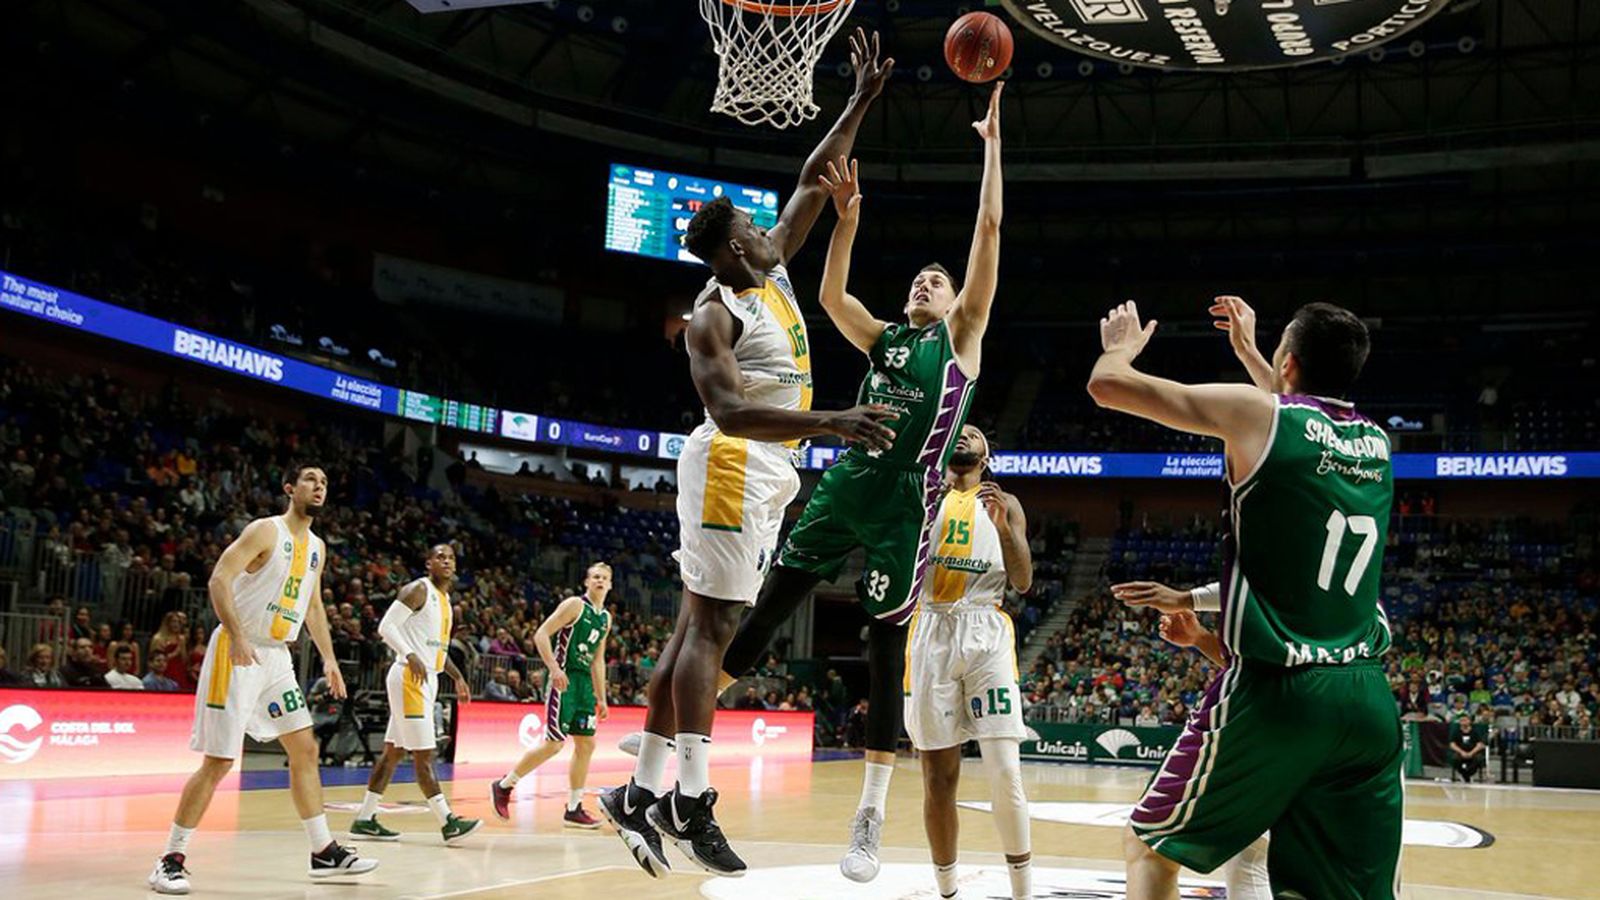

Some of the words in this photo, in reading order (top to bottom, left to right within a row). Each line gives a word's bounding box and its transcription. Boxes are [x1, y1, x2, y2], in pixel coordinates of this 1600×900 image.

[1027, 2, 1170, 64] VELAZQUEZ
[1266, 12, 1314, 55] GRUPO
[3, 275, 26, 294] The
[27, 286, 58, 305] most
[0, 292, 45, 314] natural
[46, 305, 84, 325] choice
[173, 329, 284, 382] BENAHAVIS
[884, 346, 910, 369] 33
[887, 385, 924, 399] Unicaja
[549, 422, 561, 439] 0
[638, 434, 650, 451] 0
[1166, 456, 1180, 466] La
[1181, 455, 1222, 466] elección
[1185, 465, 1222, 477] natural
[1436, 455, 1567, 476] BENAHAVIS
[944, 519, 970, 545] 15
[1317, 509, 1378, 596] 17
[284, 576, 302, 600] 83
[868, 570, 890, 602] 33
[283, 688, 306, 713] 83
[987, 688, 1011, 715] 15
[51, 722, 90, 734] COSTA
[91, 722, 113, 733] DEL
[113, 722, 136, 734] SOL
[1036, 740, 1088, 757] Unicaja
